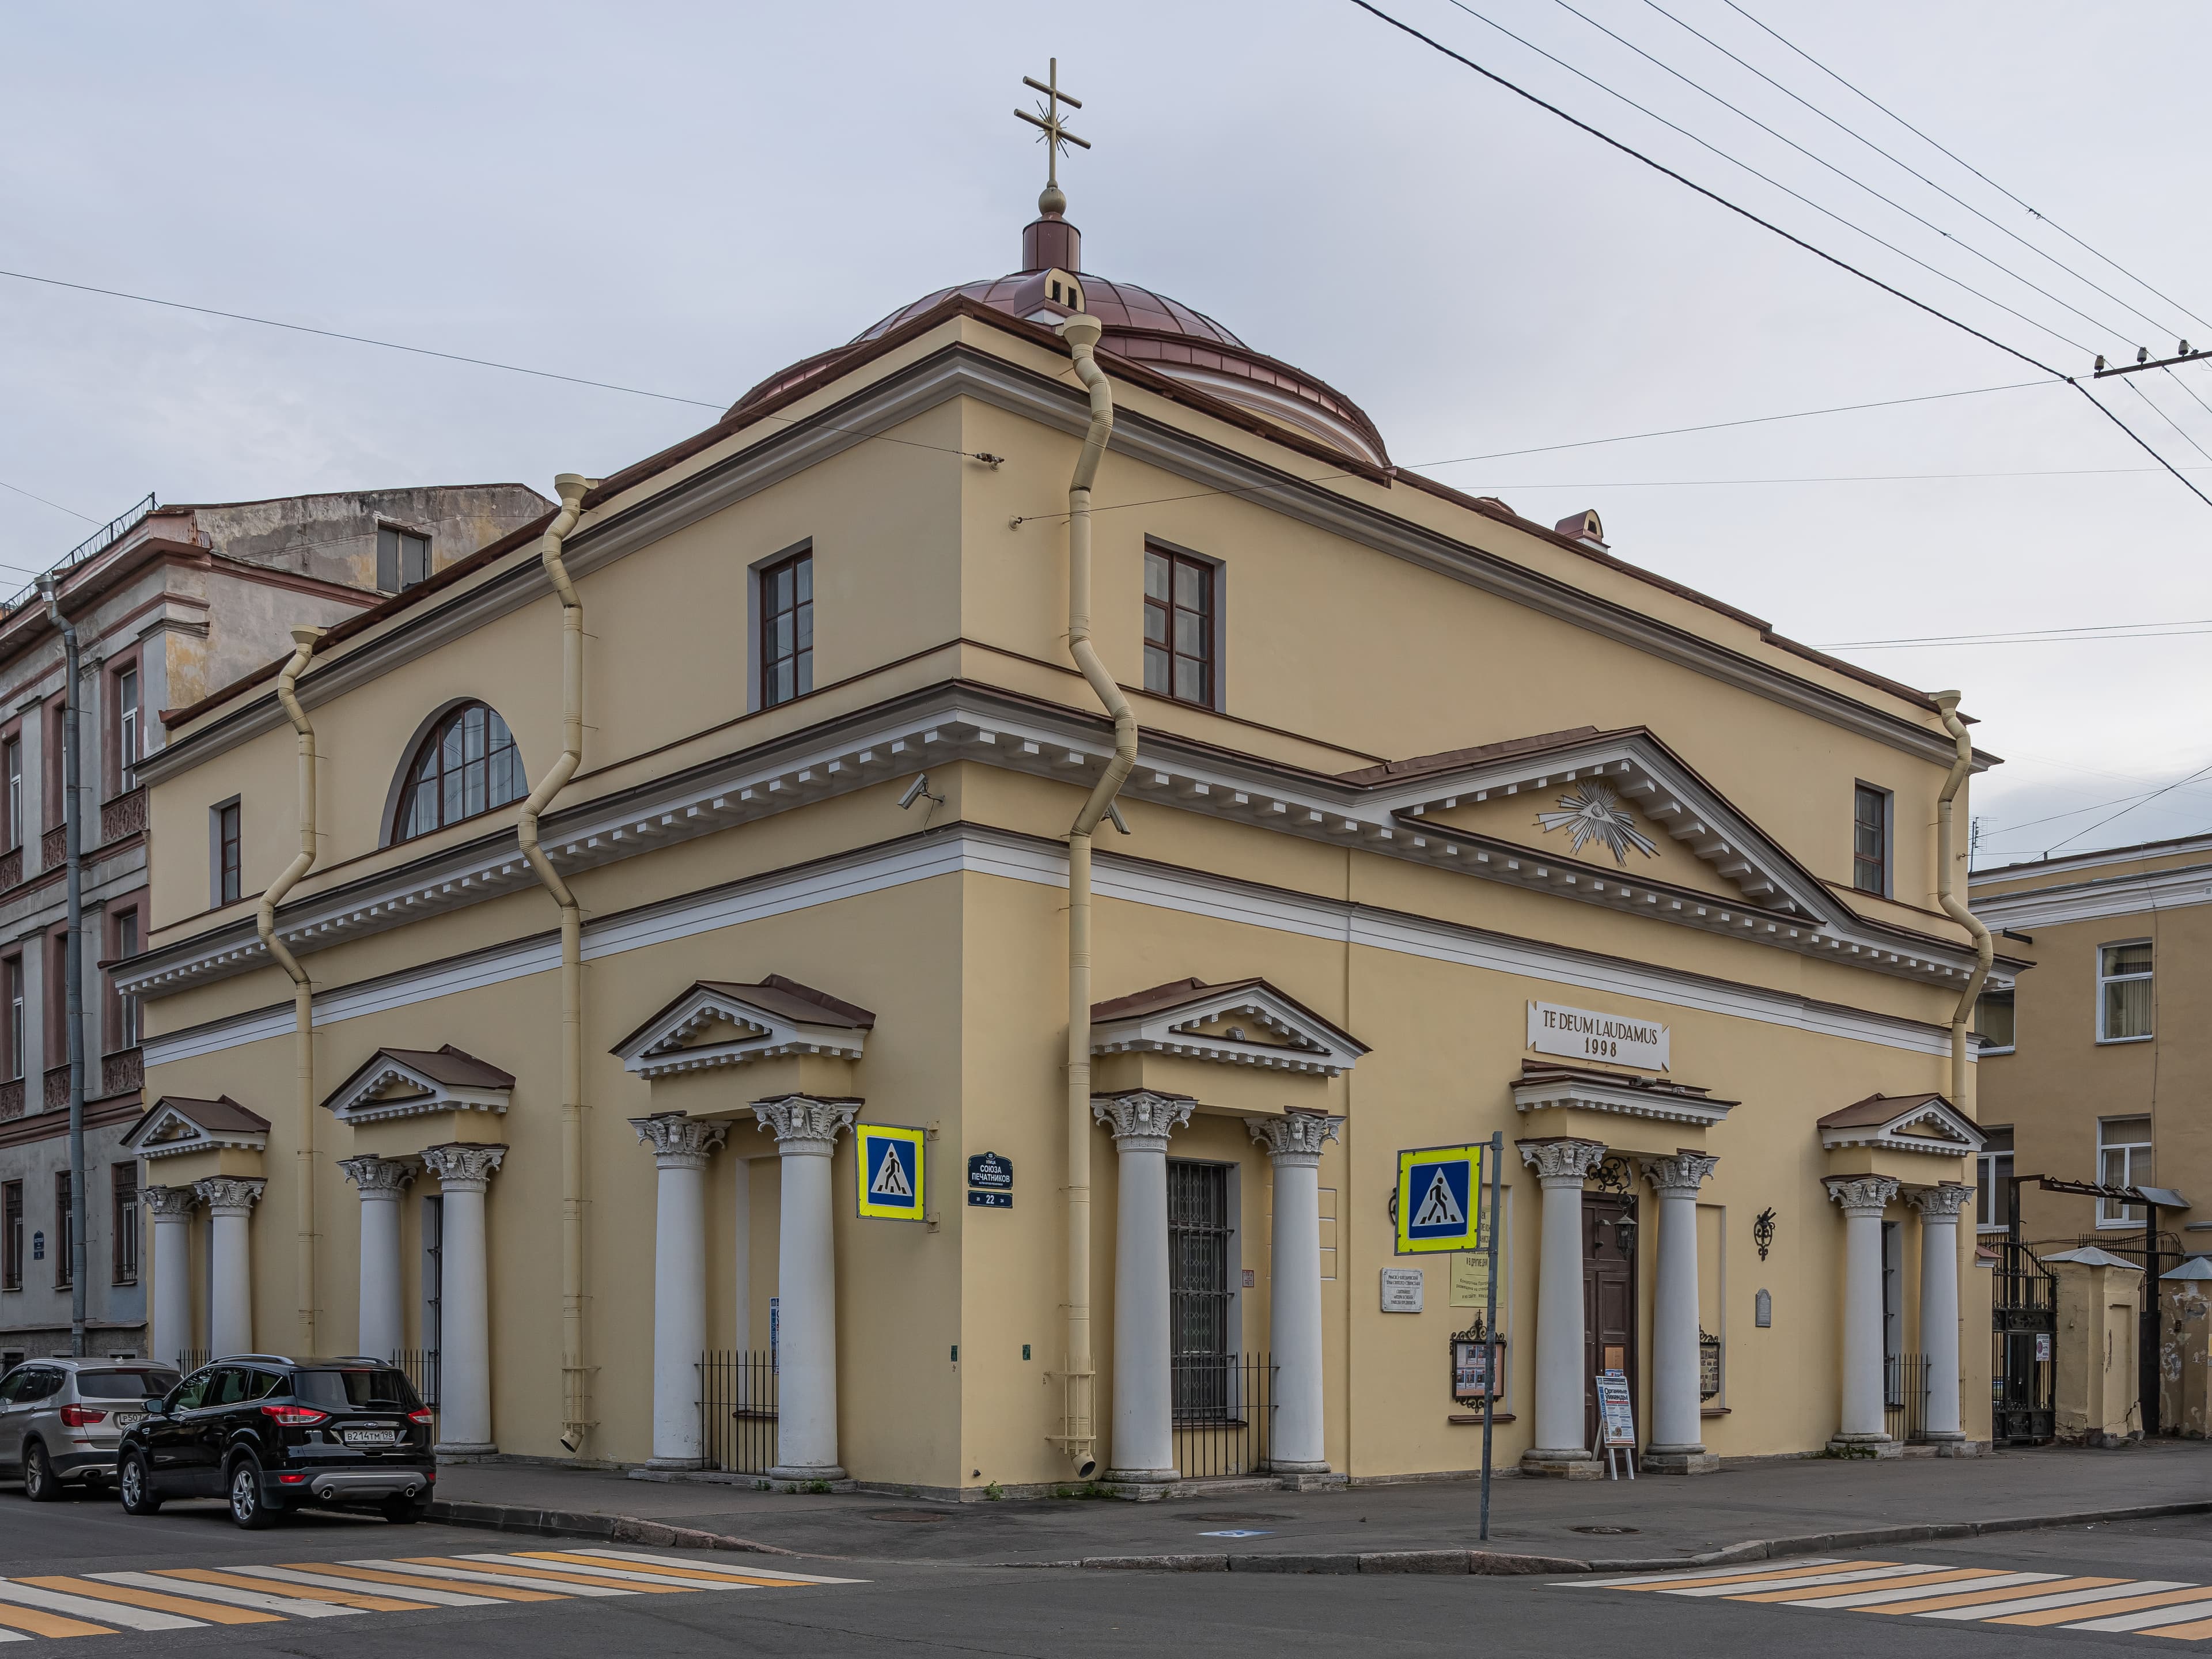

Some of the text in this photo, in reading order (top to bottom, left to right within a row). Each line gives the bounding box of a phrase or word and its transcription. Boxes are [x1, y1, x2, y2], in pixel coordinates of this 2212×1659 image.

[1543, 1010, 1657, 1044] TE DEUM LAUDAMUS
[1585, 1037, 1616, 1057] 1998
[980, 1165, 1002, 1173] СОЮЗА
[972, 1173, 1010, 1182] ПЕЧАТНИКОВ
[986, 1195, 994, 1205] 22
